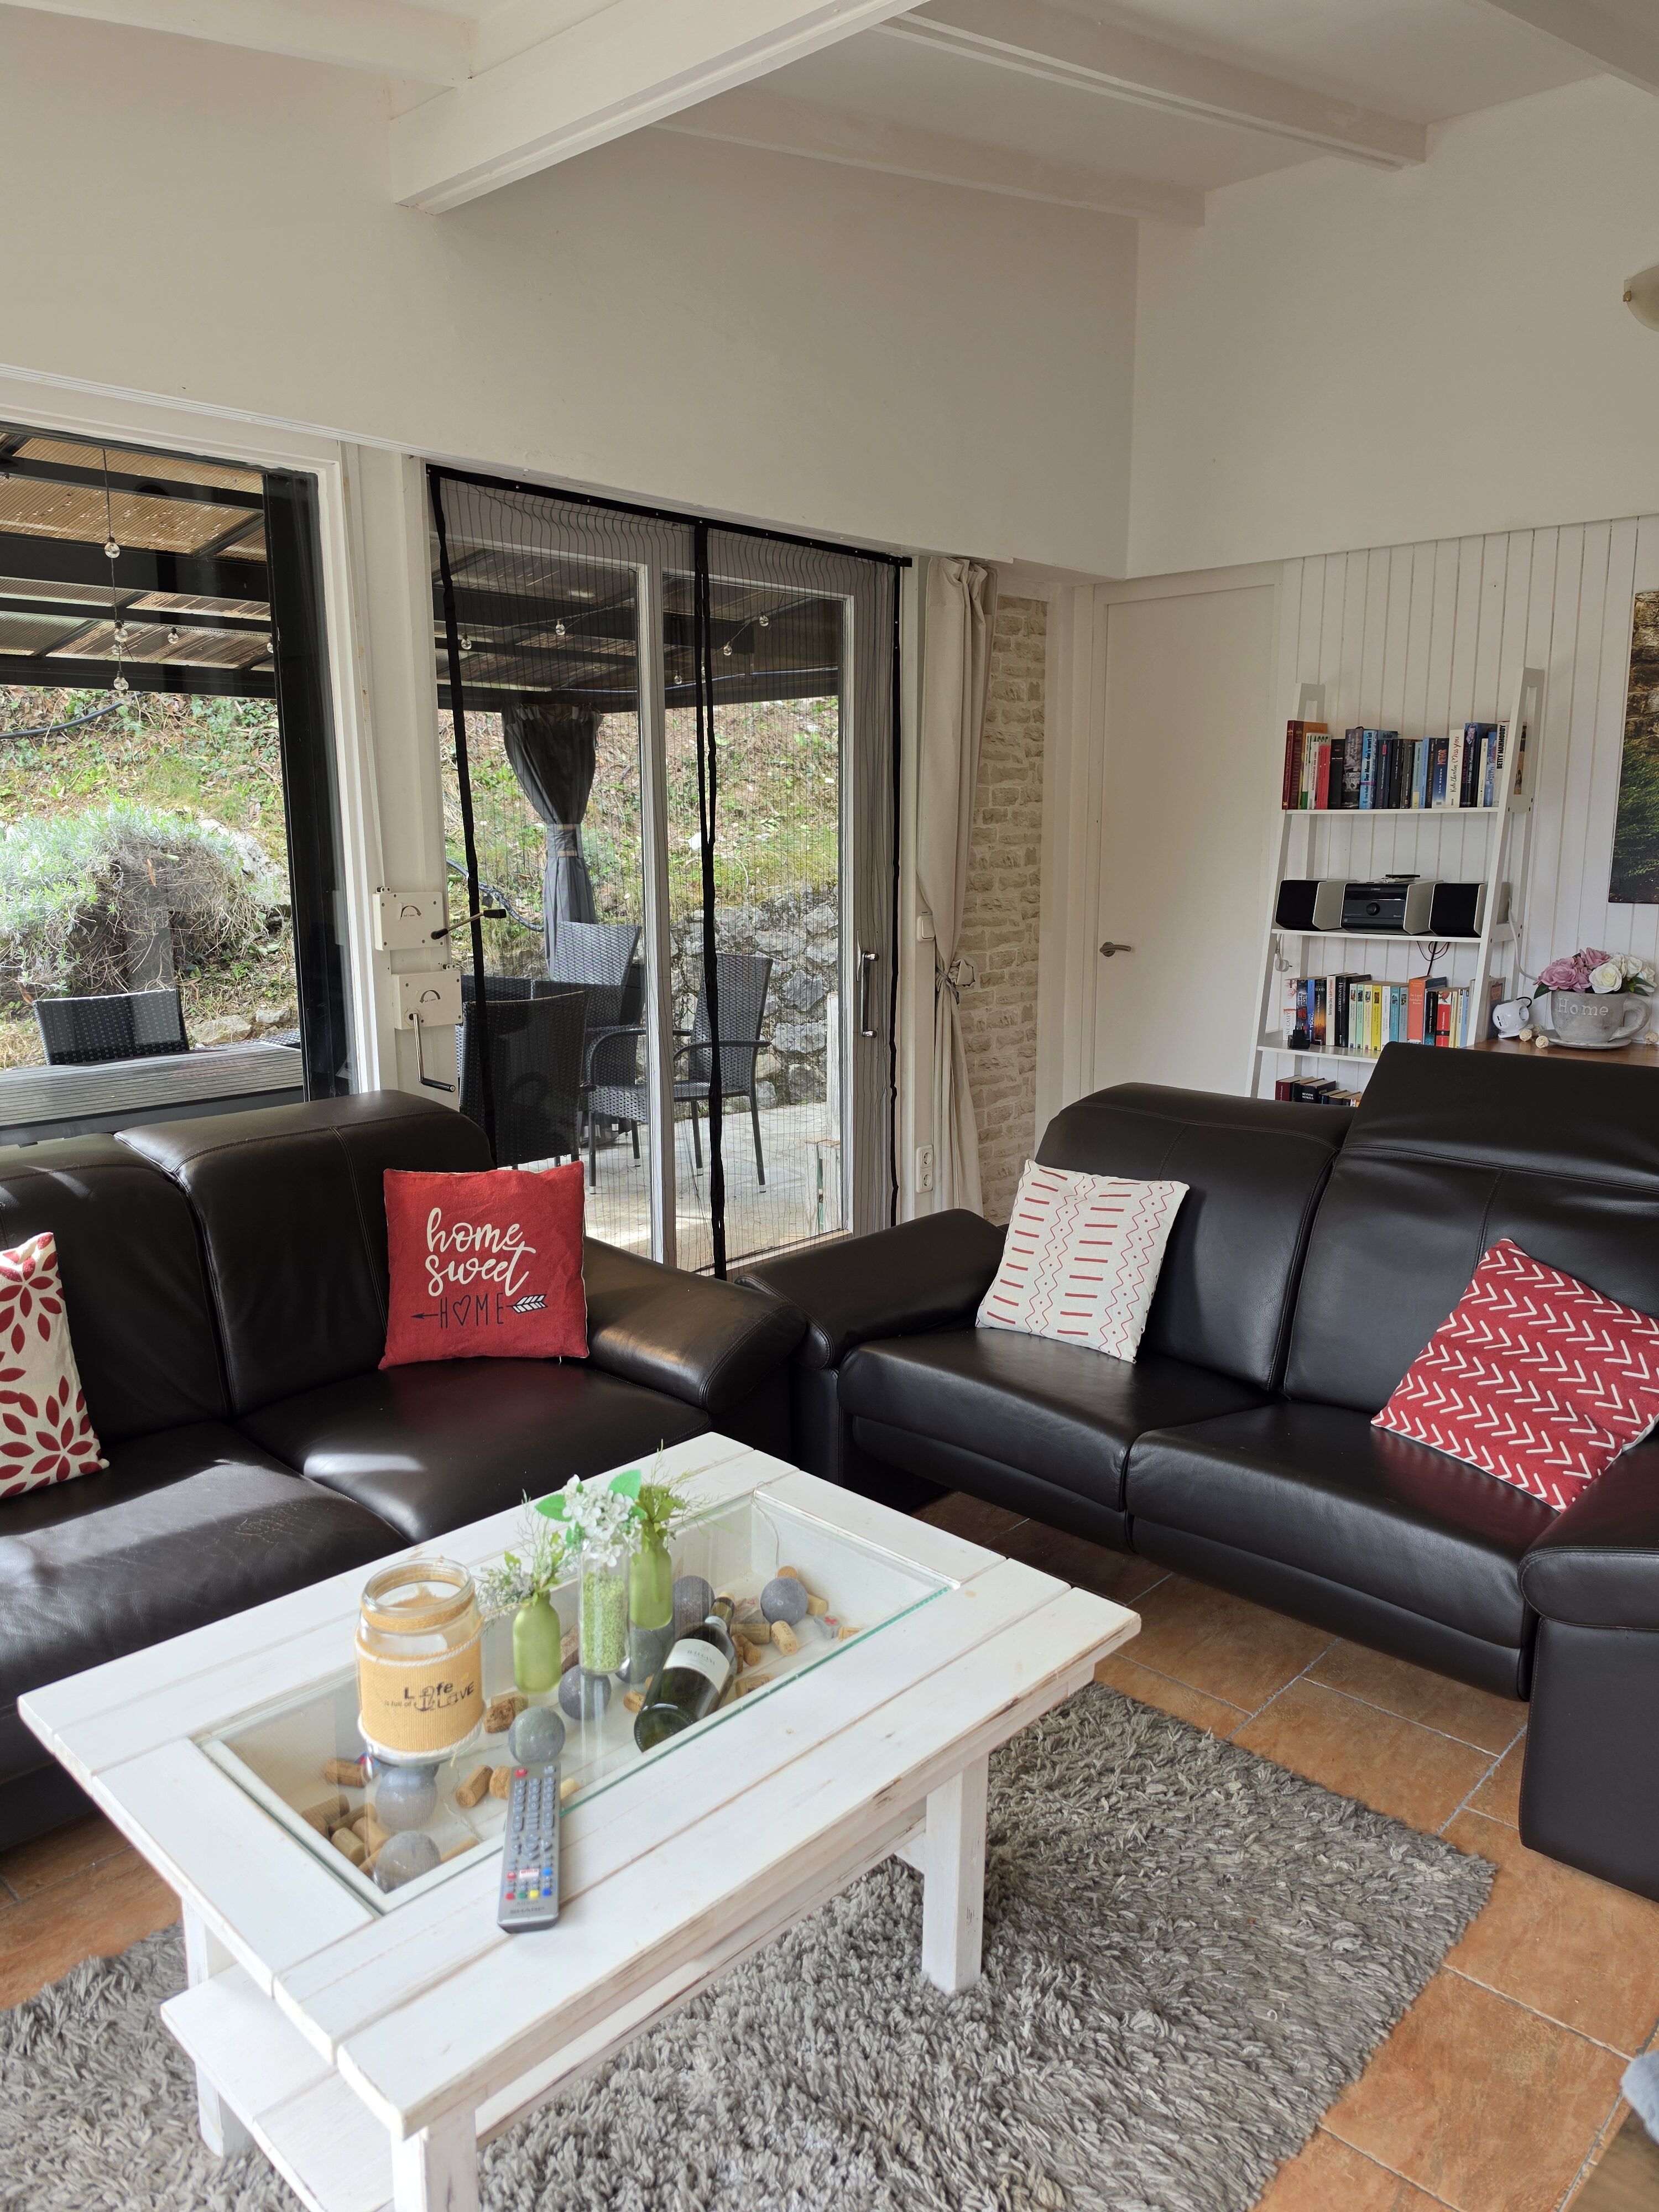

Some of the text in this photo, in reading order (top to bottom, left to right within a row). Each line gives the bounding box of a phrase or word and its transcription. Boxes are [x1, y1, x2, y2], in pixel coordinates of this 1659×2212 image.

[1438, 749, 1447, 764] METEOR
[1557, 998, 1609, 1016] Home
[426, 1207, 523, 1253] home
[425, 1241, 536, 1297] sweet
